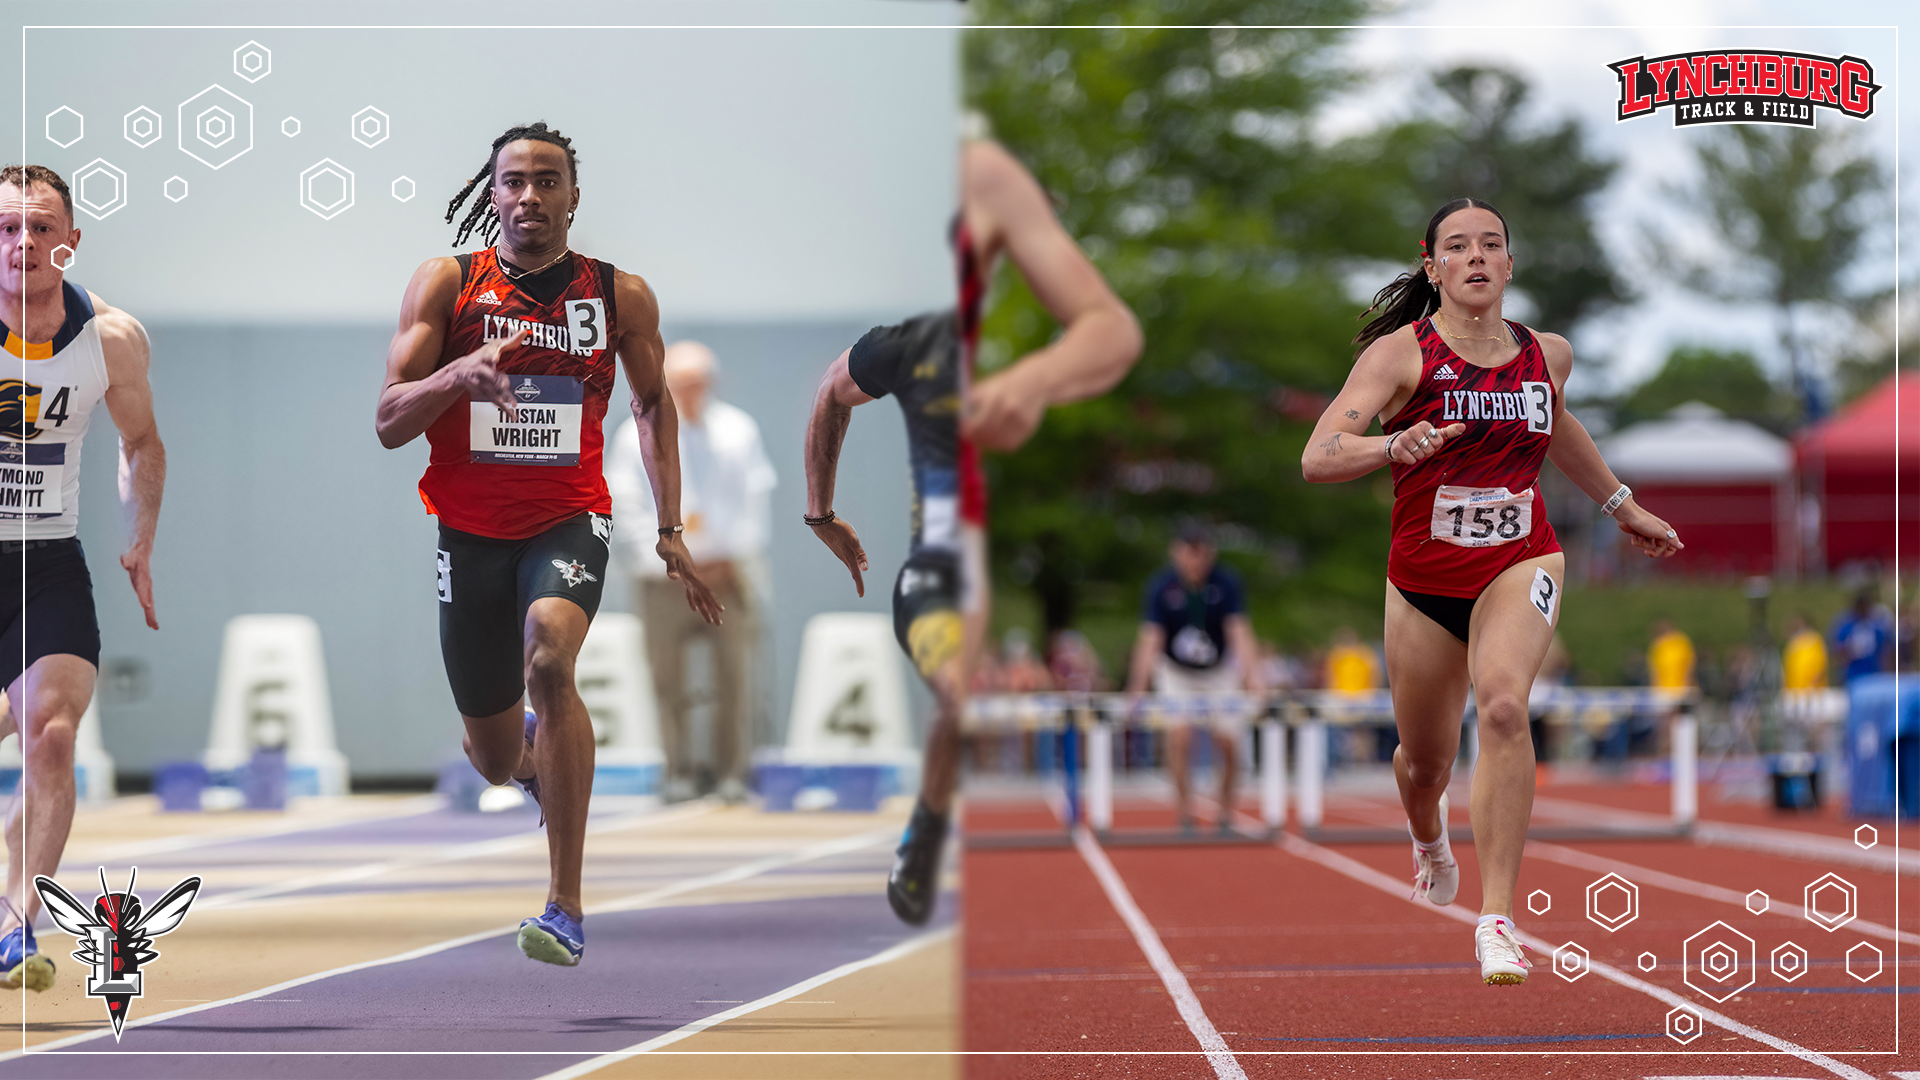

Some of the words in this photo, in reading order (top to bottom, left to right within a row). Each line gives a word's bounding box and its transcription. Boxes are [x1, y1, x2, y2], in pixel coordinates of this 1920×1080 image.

[476, 297, 502, 306] adidas
[483, 314, 593, 357] LYNCHBU
[574, 302, 599, 348] 3
[43, 386, 70, 428] 4
[1443, 390, 1528, 420] LYNCHBU
[1531, 384, 1548, 431] 3
[492, 428, 561, 448] WRIGHT
[0, 468, 44, 485] MOND
[1446, 505, 1521, 539] 158
[1536, 575, 1553, 615] 3
[822, 676, 878, 748] 4
